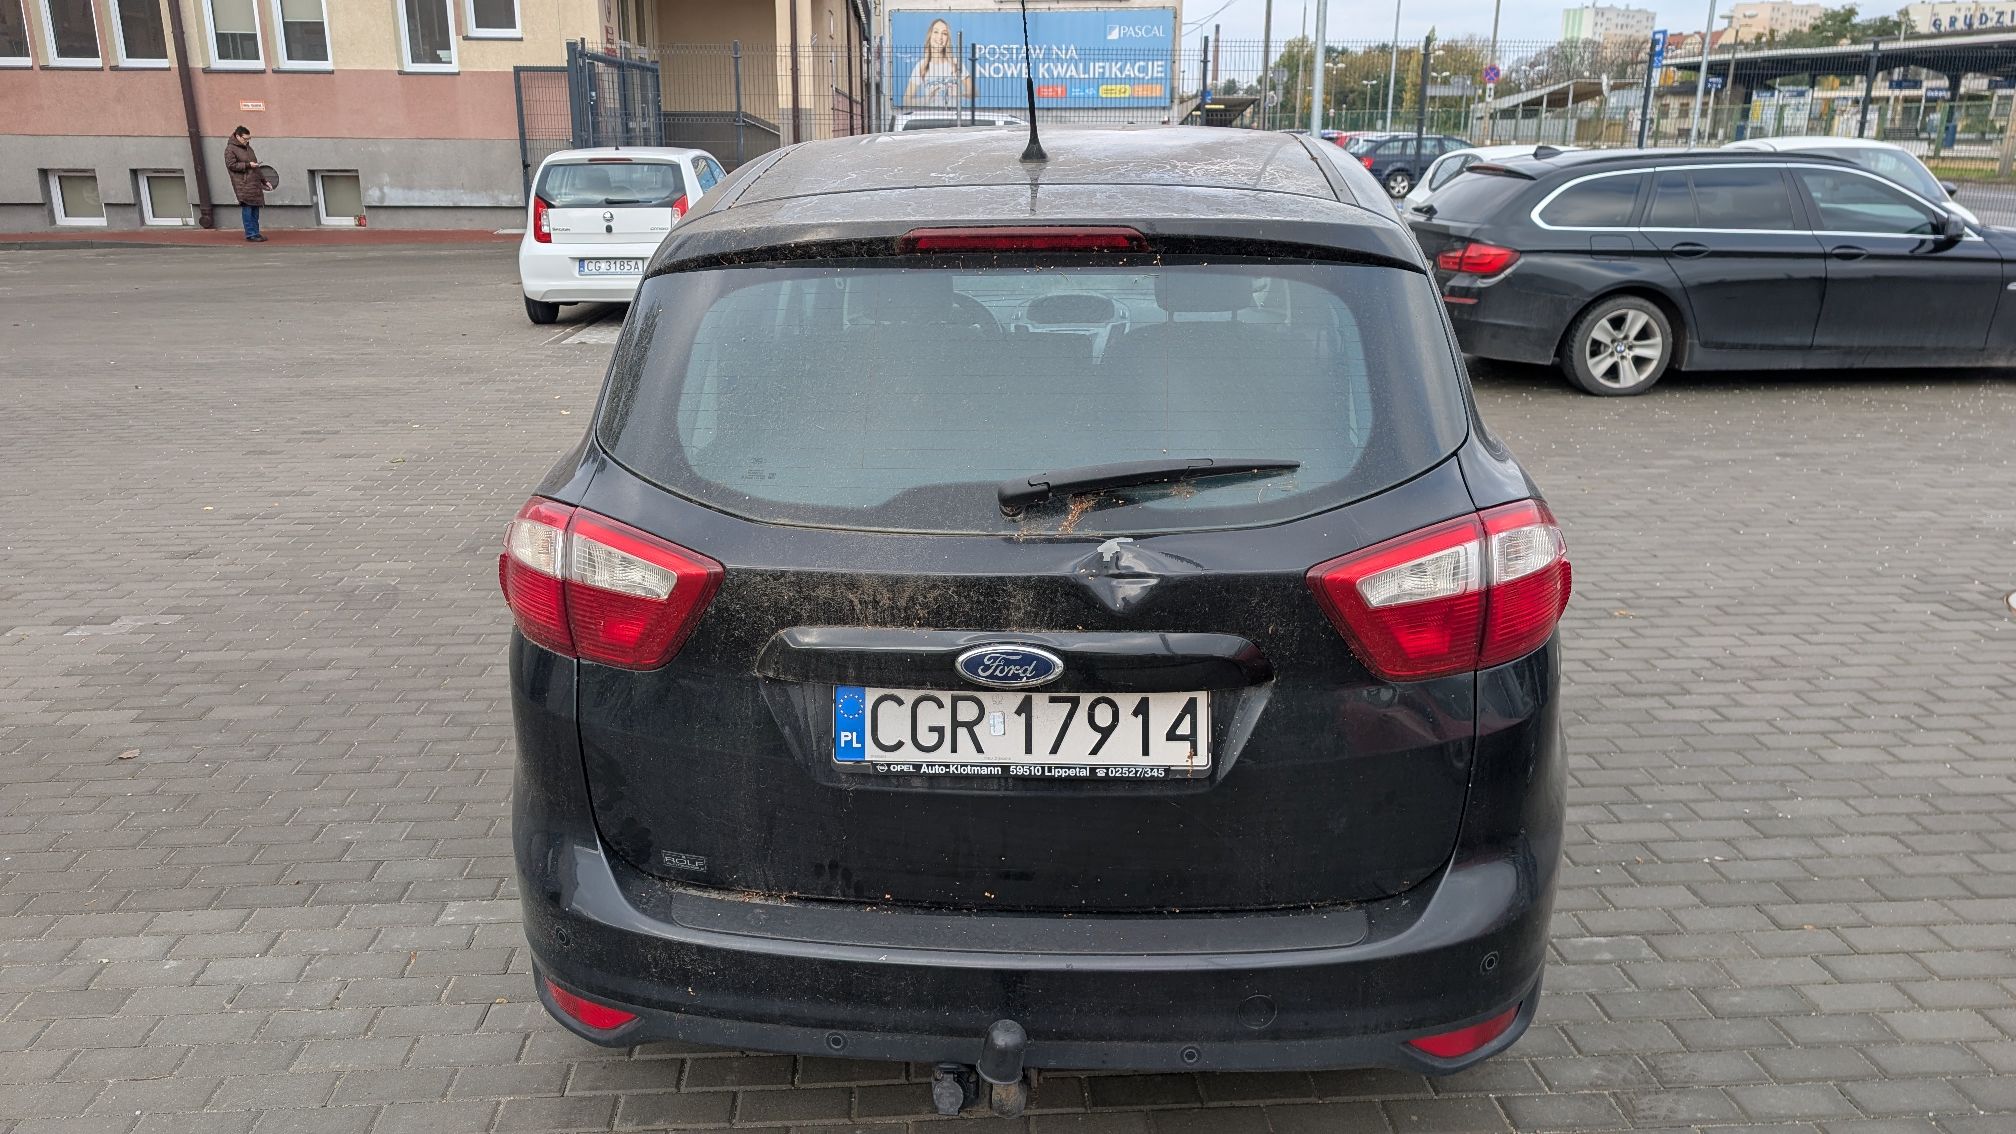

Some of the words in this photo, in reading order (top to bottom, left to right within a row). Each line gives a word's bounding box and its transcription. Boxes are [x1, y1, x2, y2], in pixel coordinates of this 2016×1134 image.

[1120, 25, 1166, 38] PASCAL
[975, 44, 1046, 60] POSTAW
[1052, 44, 1079, 60] NA
[1039, 61, 1165, 80] KWALIFIKACJE
[586, 260, 601, 271] CG
[605, 260, 640, 271] 3185A
[978, 653, 1037, 677] Ford
[840, 731, 862, 748] PL
[870, 693, 986, 754] CGR
[1014, 694, 1198, 757] 17914
[890, 764, 916, 772] OPEL
[920, 763, 1002, 776] Auto-Klotmann
[1009, 765, 1042, 776] 59510
[1044, 766, 1090, 777] Lippetal
[1108, 767, 1165, 778] 02527/345
